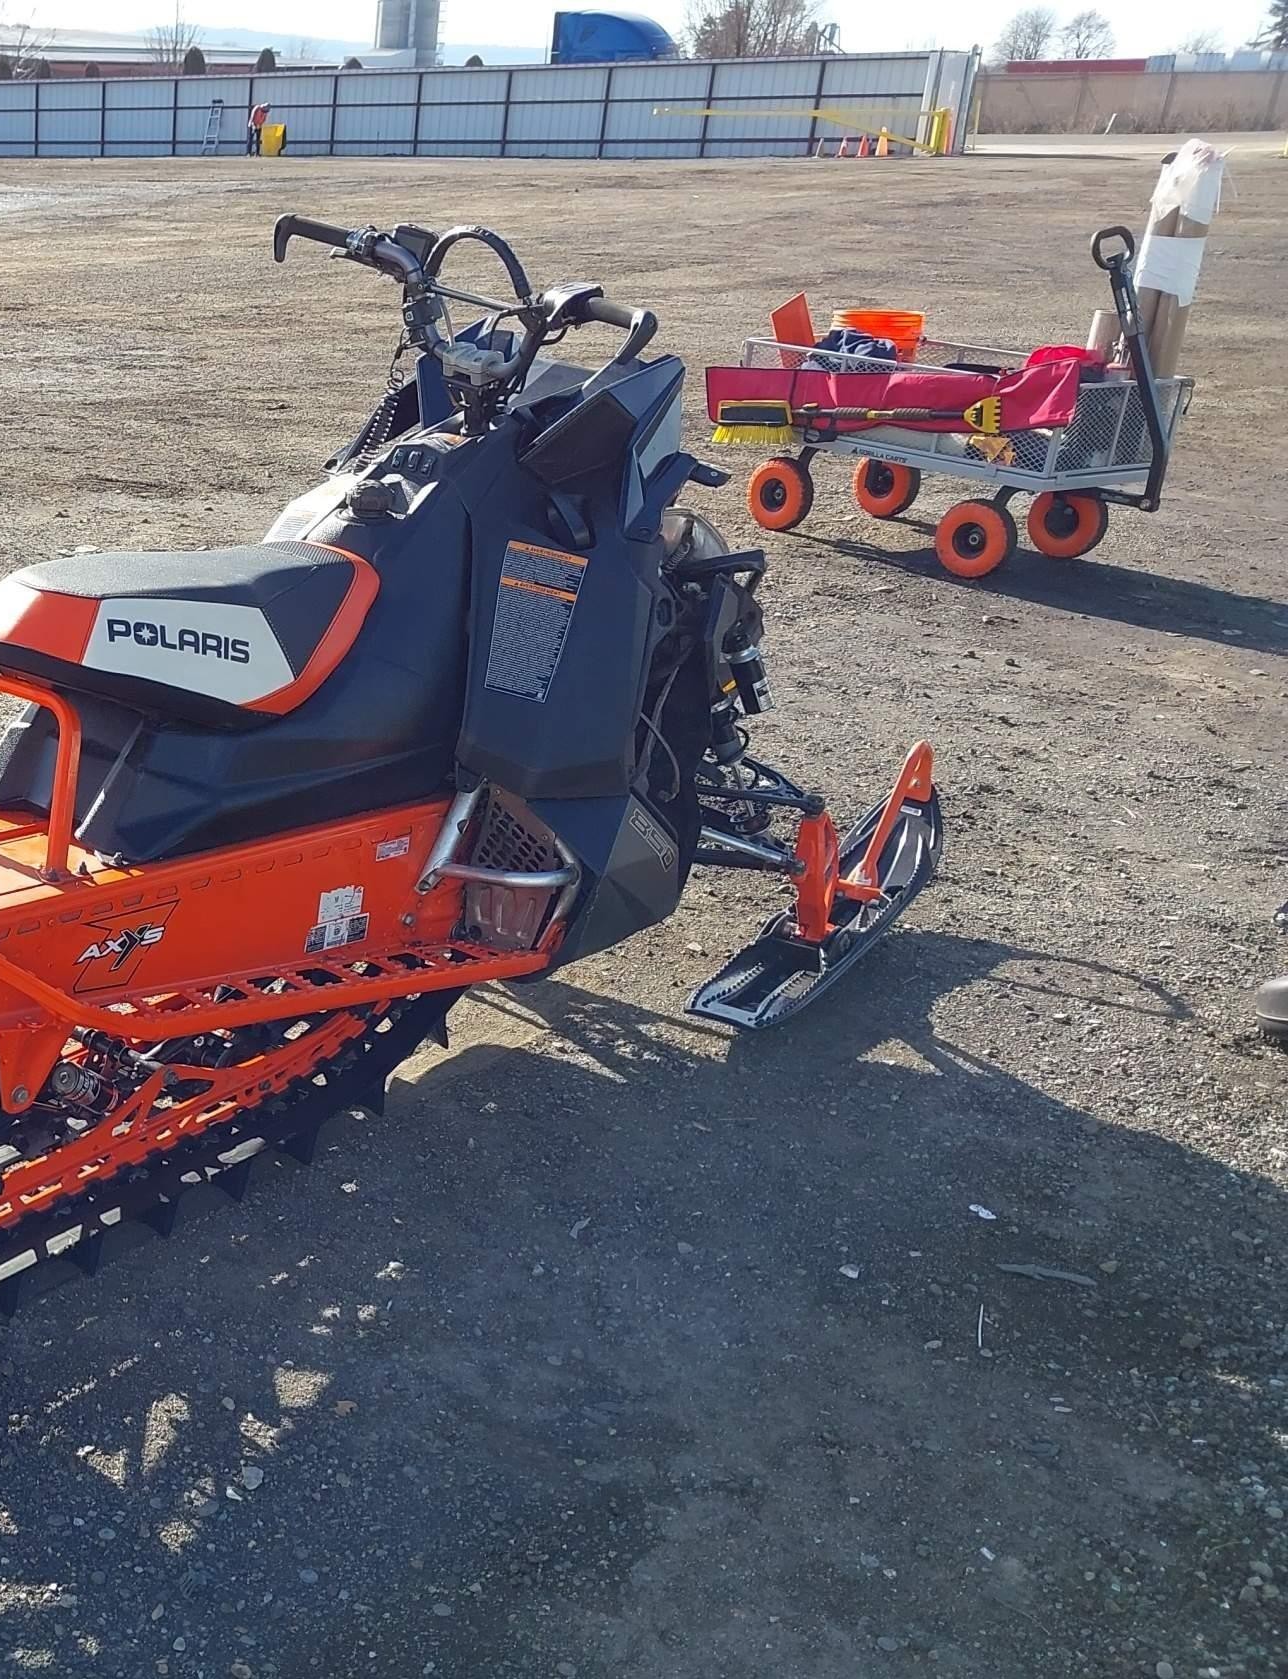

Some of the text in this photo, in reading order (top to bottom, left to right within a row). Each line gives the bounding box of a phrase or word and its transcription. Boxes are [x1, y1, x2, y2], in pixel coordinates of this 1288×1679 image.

[107, 618, 250, 665] POLARIS
[628, 808, 675, 873] 850
[75, 922, 165, 972] AXYS
